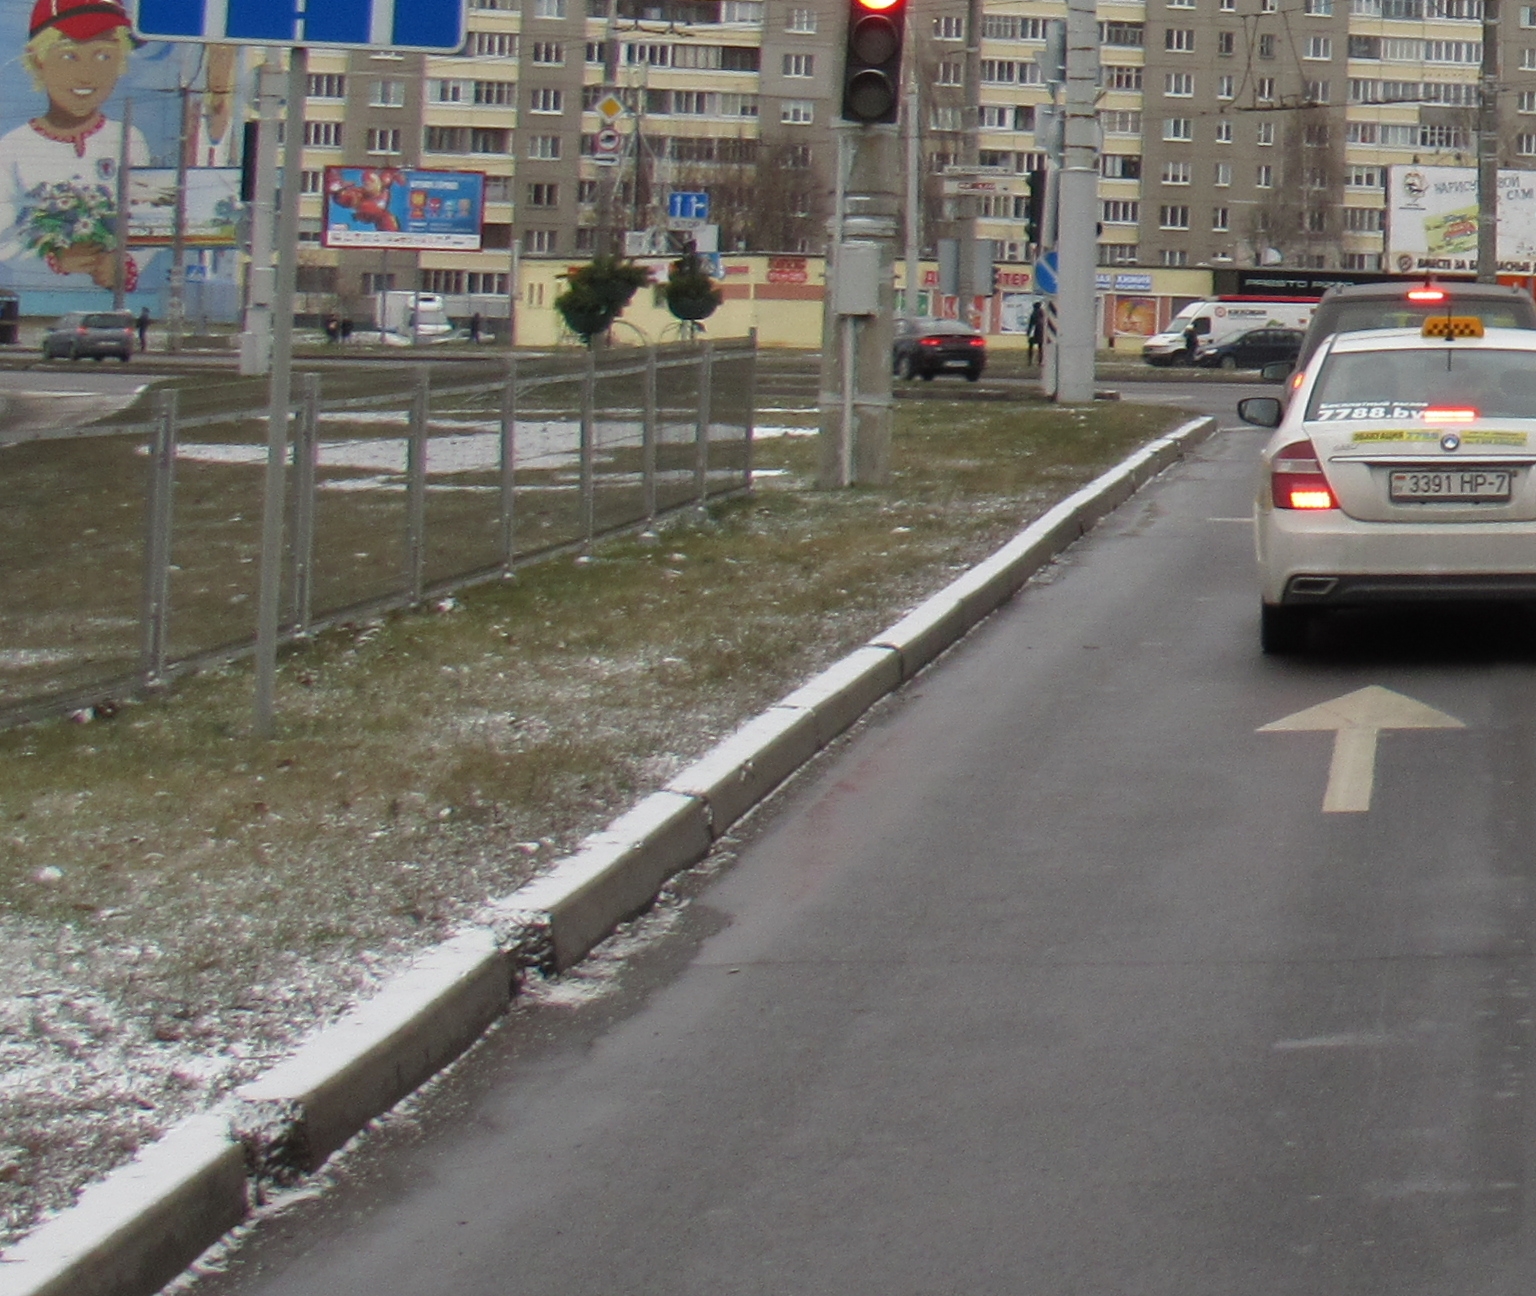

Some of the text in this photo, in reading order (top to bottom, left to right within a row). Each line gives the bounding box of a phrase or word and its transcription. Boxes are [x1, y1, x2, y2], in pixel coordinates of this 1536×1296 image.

[1433, 178, 1478, 195] НАРИСУ
[1409, 474, 1506, 494] 3391 HP-7
